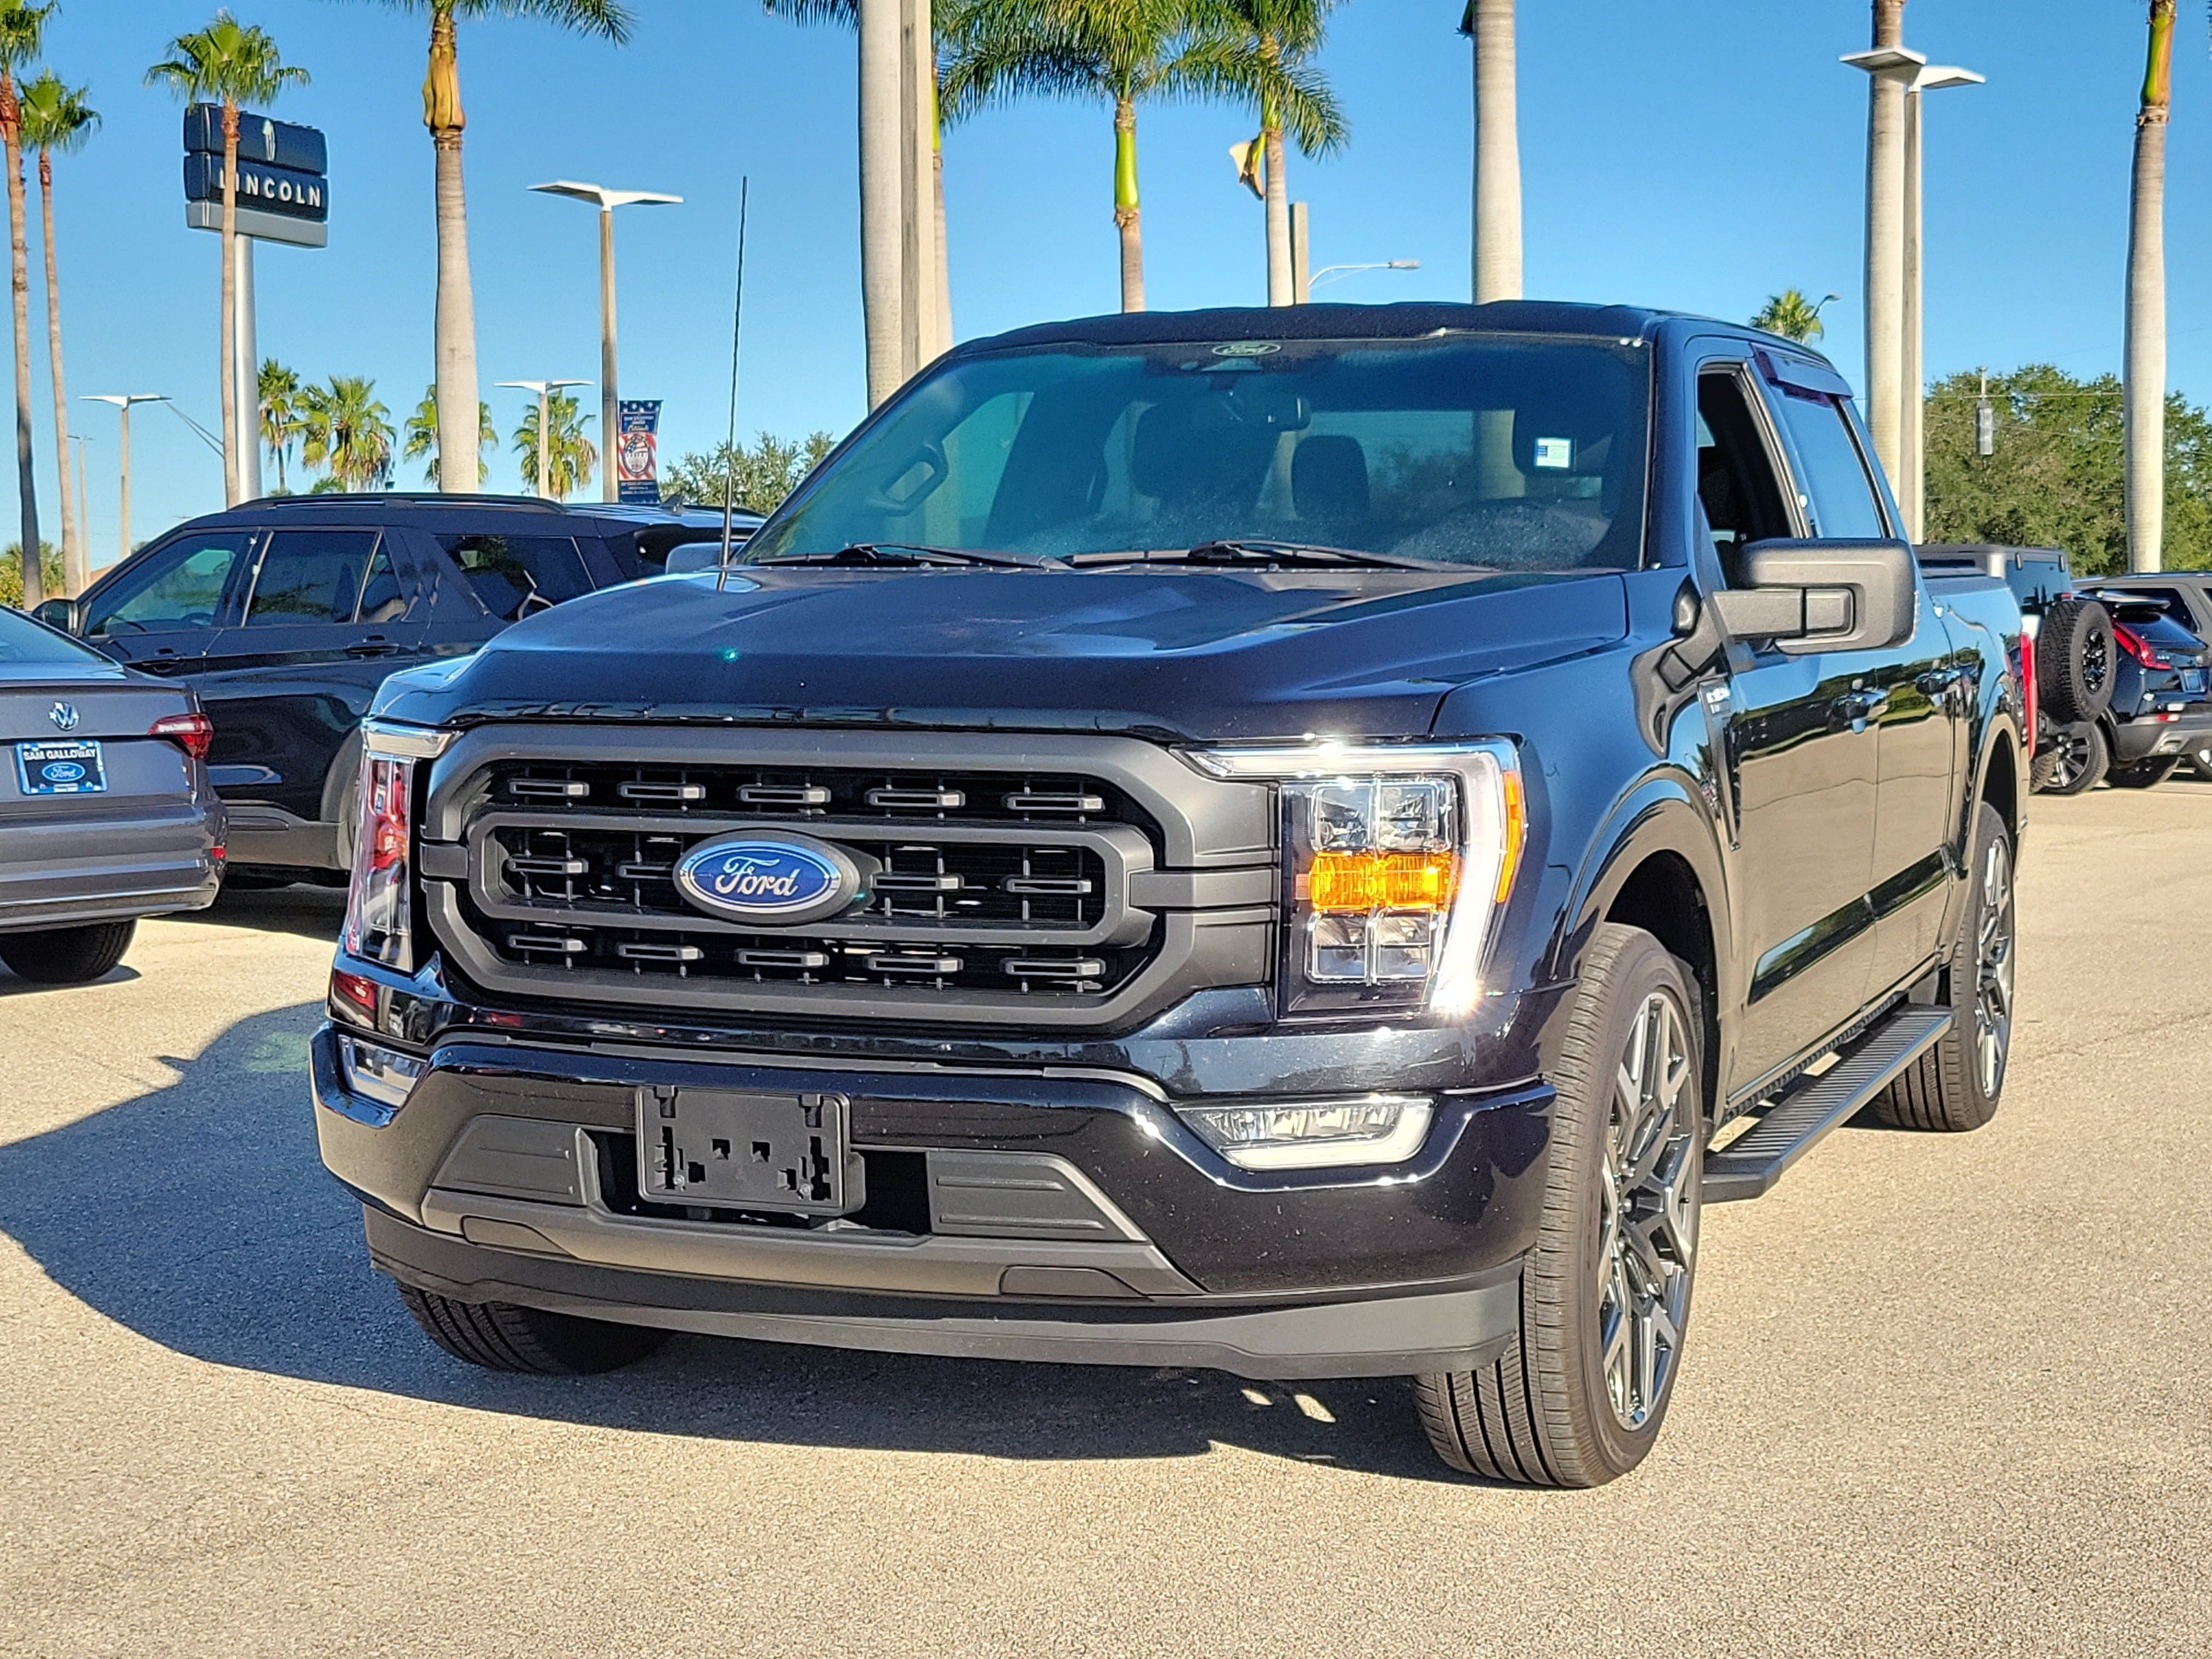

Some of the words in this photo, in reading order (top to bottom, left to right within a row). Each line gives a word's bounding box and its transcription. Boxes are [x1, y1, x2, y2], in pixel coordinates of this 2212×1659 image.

[1222, 344, 1269, 354] Ford
[23, 750, 46, 760] SAM
[46, 748, 96, 759] GALLOWAY
[50, 765, 76, 778] Ford
[715, 856, 799, 896] Ford
